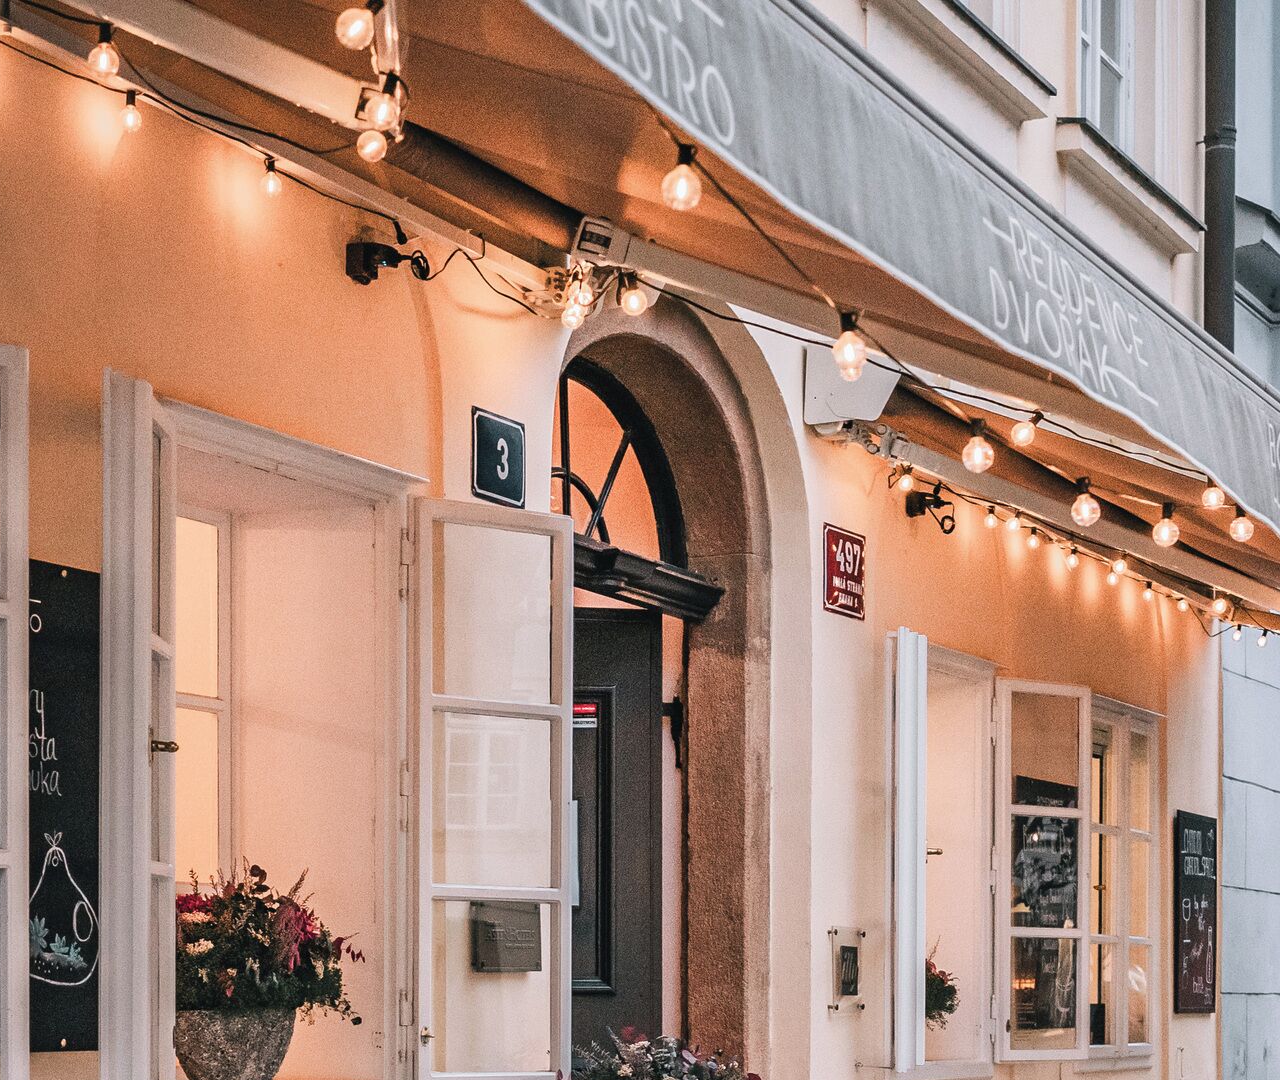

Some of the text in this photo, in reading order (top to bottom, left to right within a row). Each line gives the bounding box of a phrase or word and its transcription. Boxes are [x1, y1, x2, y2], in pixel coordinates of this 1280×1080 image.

[1008, 215, 1150, 368] REZIDENCE
[496, 438, 509, 480] 3
[835, 538, 861, 576] 497
